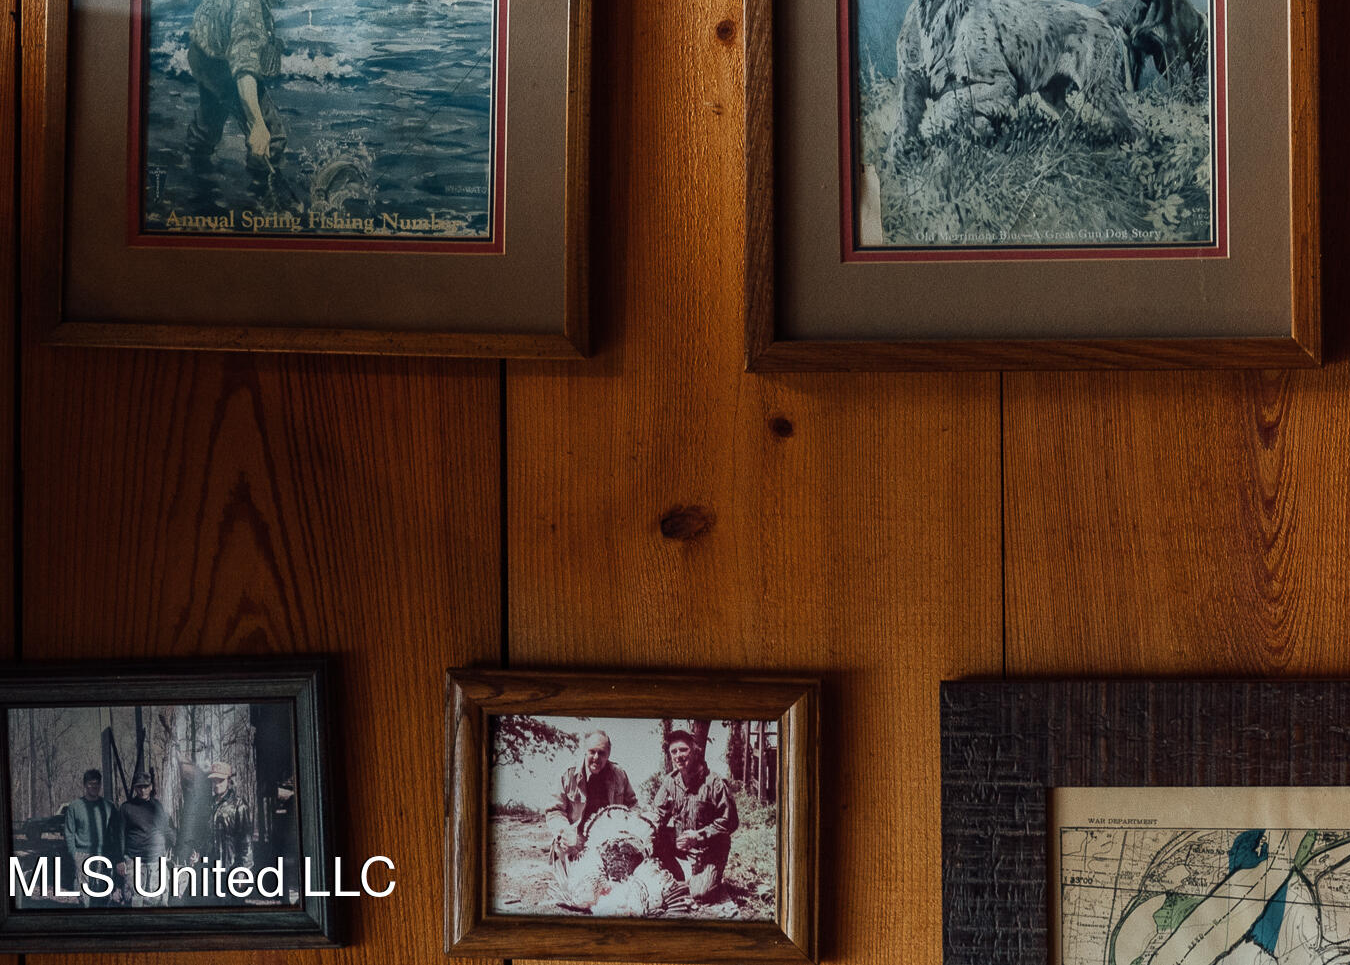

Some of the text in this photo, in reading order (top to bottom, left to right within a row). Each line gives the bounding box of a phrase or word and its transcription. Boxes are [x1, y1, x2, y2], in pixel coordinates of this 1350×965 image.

[165, 210, 235, 229] Annual
[241, 210, 302, 233] Spring
[308, 211, 375, 234] Fishing
[1078, 229, 1102, 240] Gun
[1105, 228, 1129, 242] Dog
[1131, 227, 1163, 241] Story
[1108, 818, 1159, 826] DEPARTMENT
